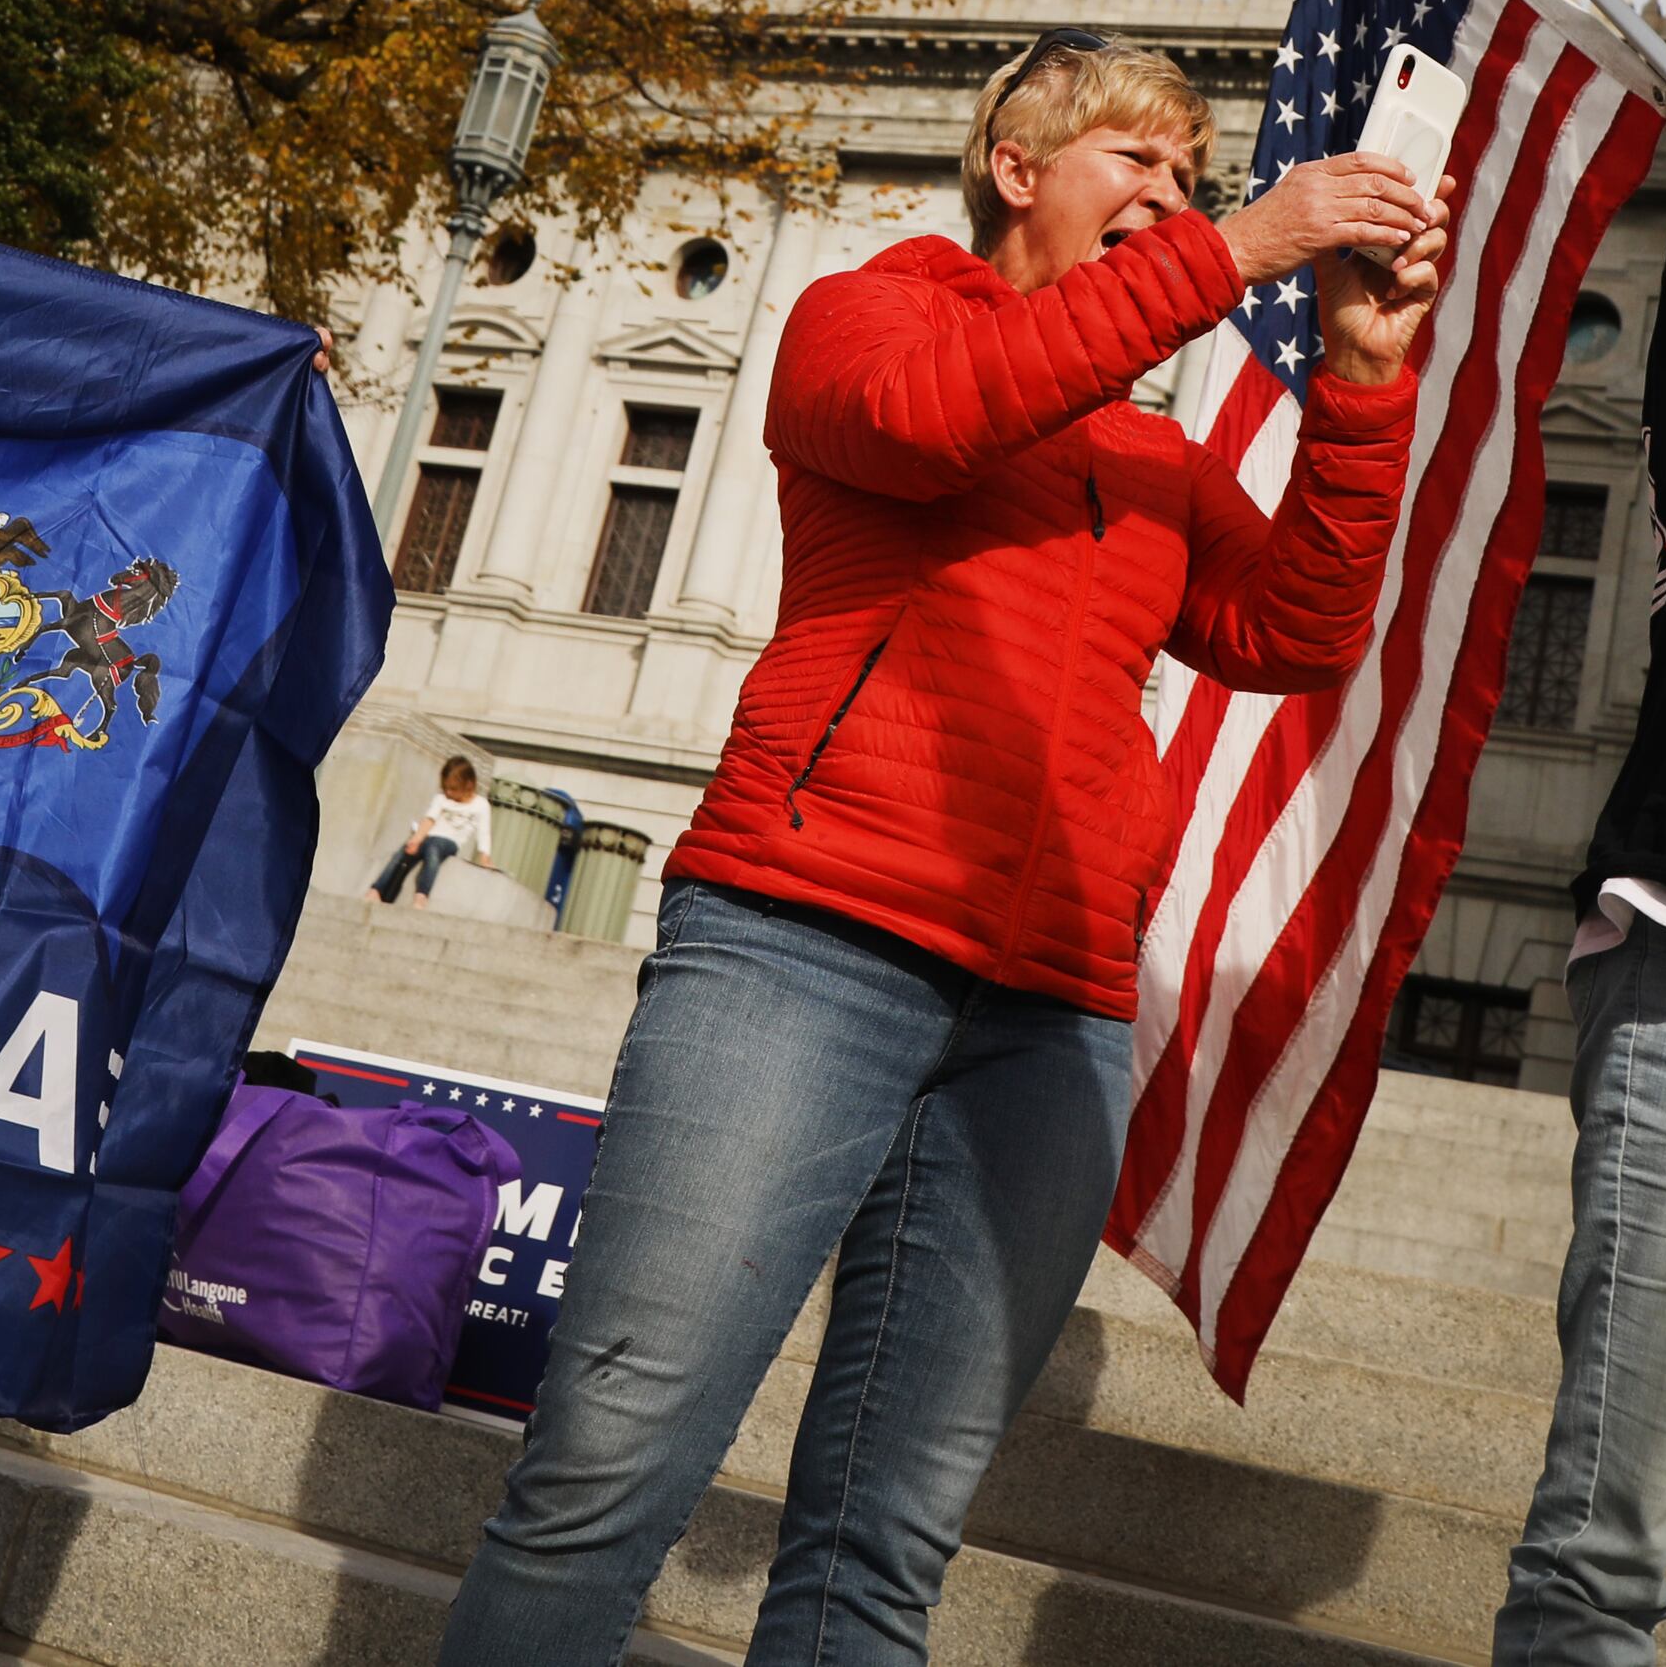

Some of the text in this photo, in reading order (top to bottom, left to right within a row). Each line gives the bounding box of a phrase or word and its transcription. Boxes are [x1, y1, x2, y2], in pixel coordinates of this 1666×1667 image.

[183, 1272, 248, 1305] Langone
[181, 1295, 225, 1326] Health
[464, 1298, 530, 1328] REAT!
